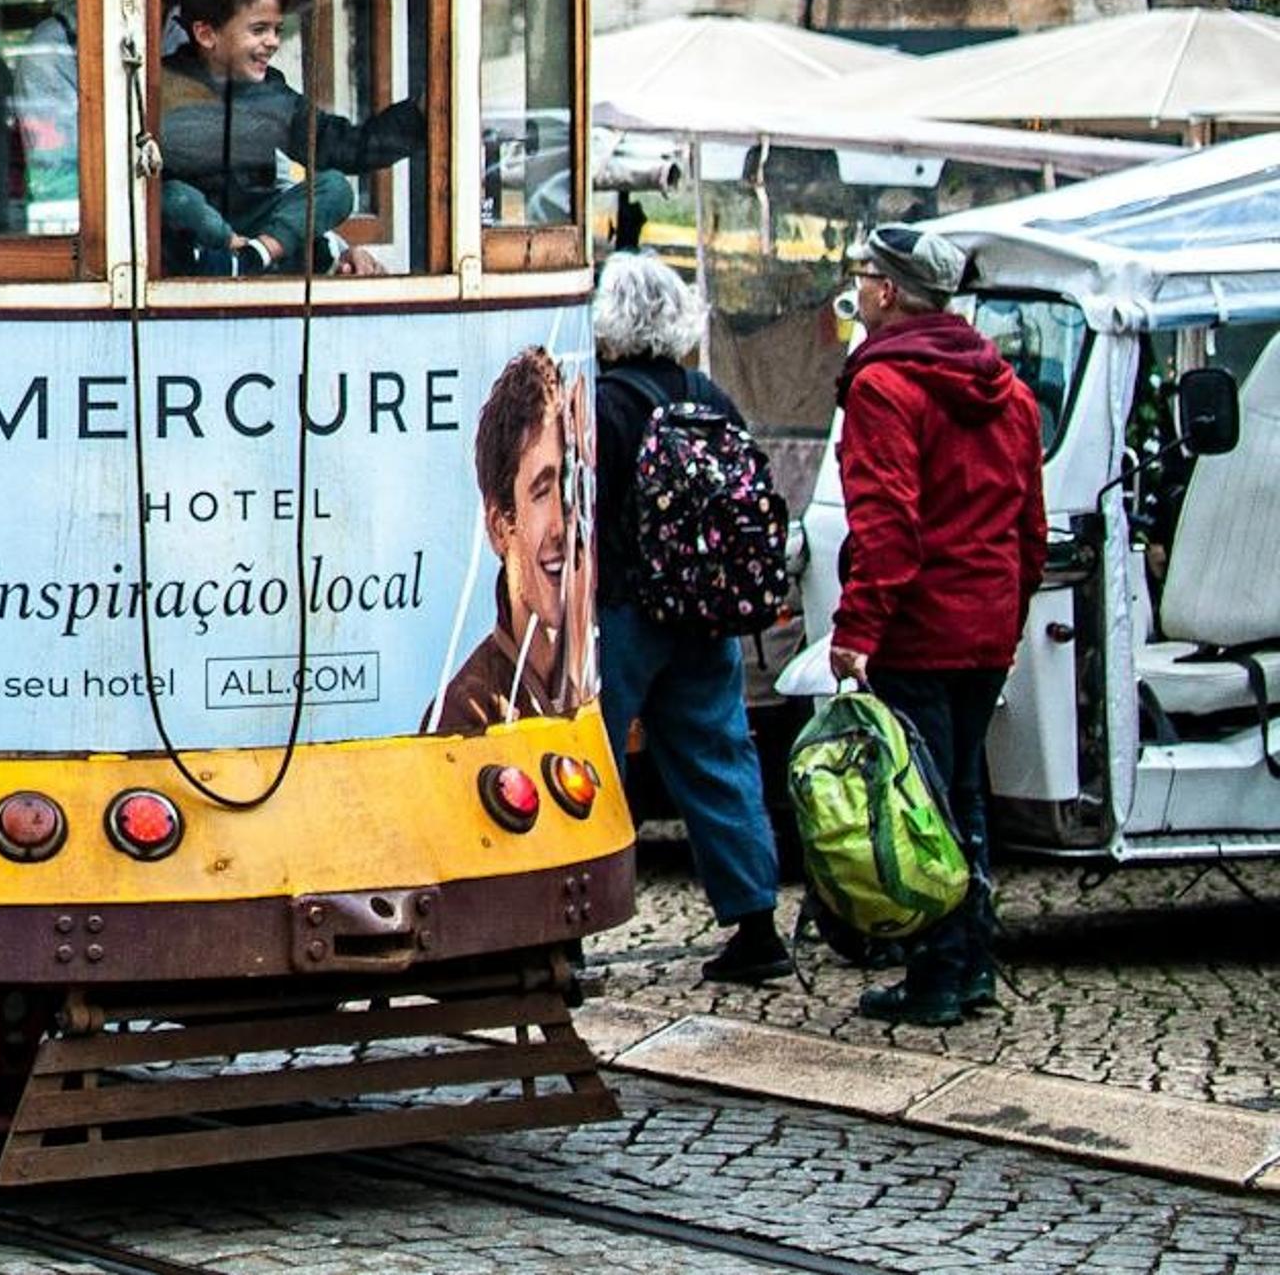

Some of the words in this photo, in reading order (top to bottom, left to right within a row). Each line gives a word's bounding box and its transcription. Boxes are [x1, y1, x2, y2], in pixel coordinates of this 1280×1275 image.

[143, 488, 332, 522] HOTEL
[308, 551, 424, 615] local
[4, 675, 70, 698] seu
[82, 667, 175, 698] hotel
[220, 665, 367, 696] ALL.COM
